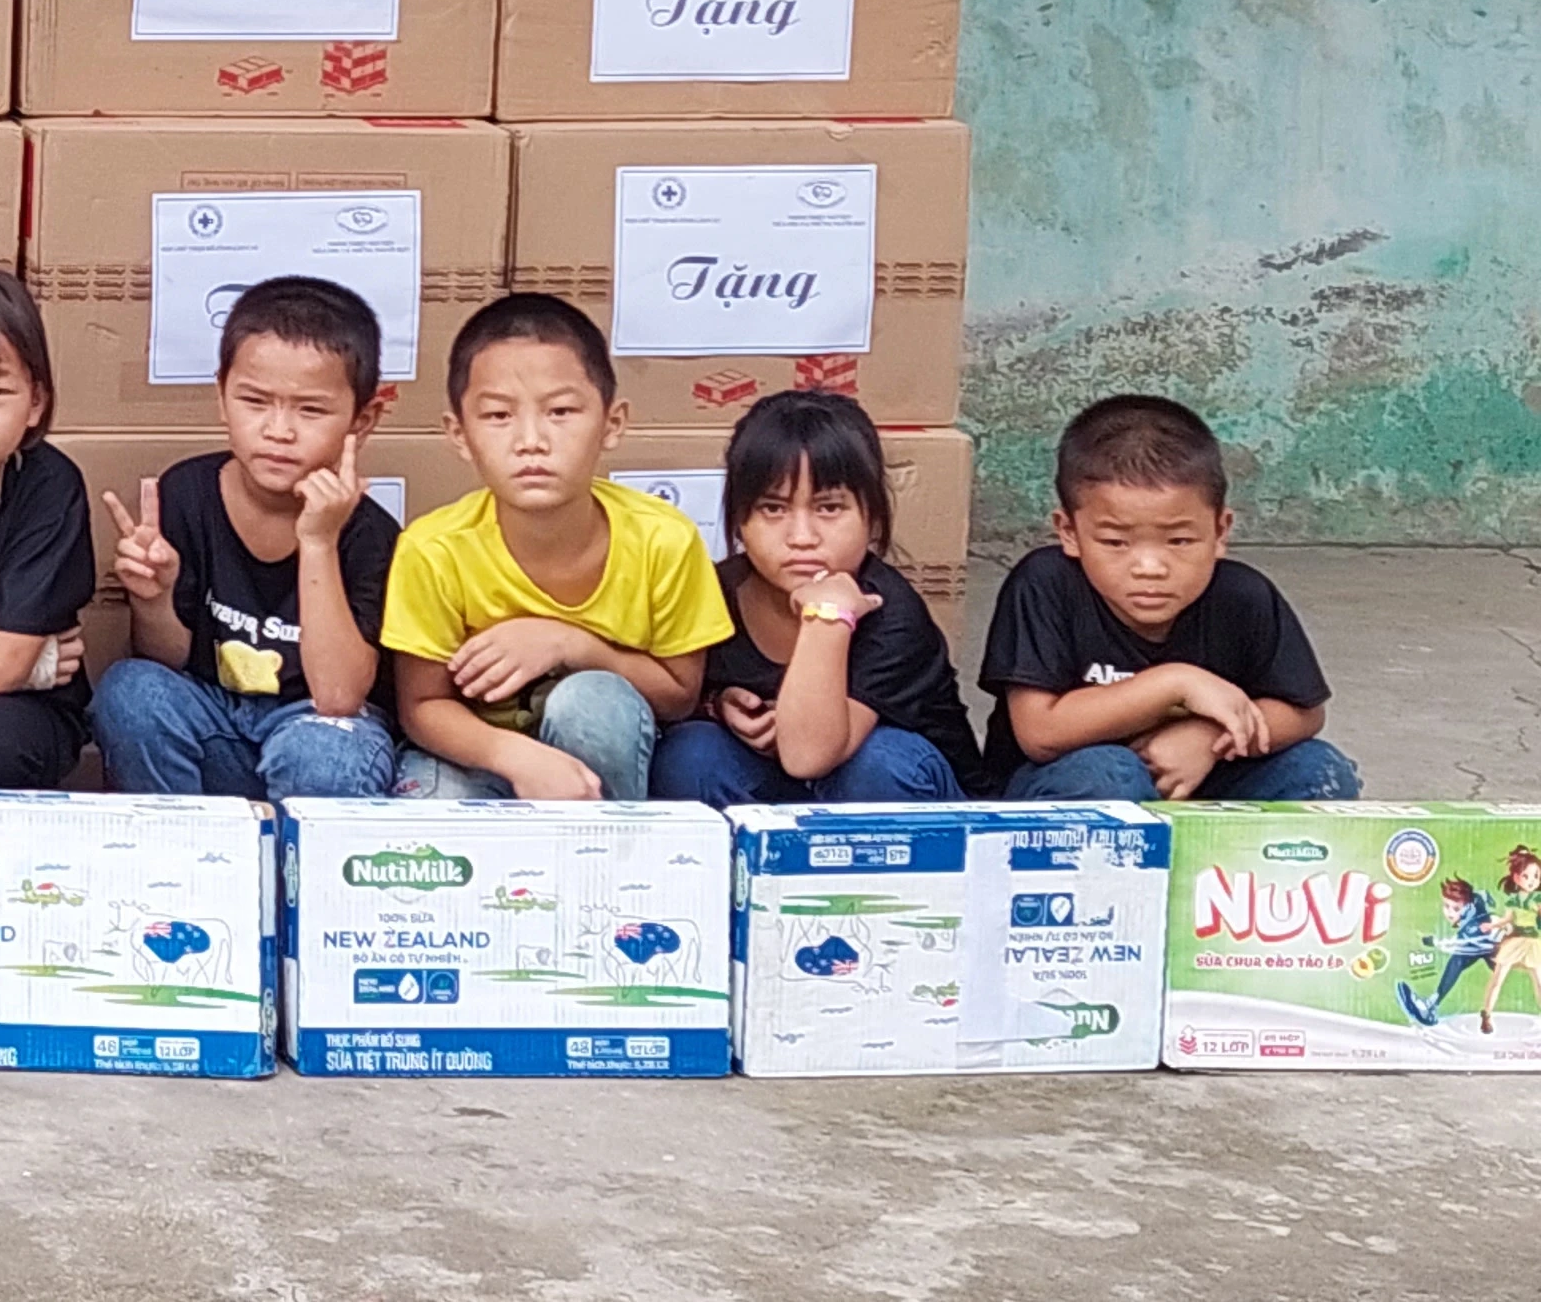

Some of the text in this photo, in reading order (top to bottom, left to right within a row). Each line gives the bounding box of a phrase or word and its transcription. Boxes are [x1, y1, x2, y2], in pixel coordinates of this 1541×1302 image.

[667, 255, 821, 309] Tặng
[352, 857, 463, 883] NutiMilk
[323, 927, 490, 948] NEW ZEALAND
[1227, 956, 1262, 969] CHUA
[1202, 1041, 1217, 1053] 12
